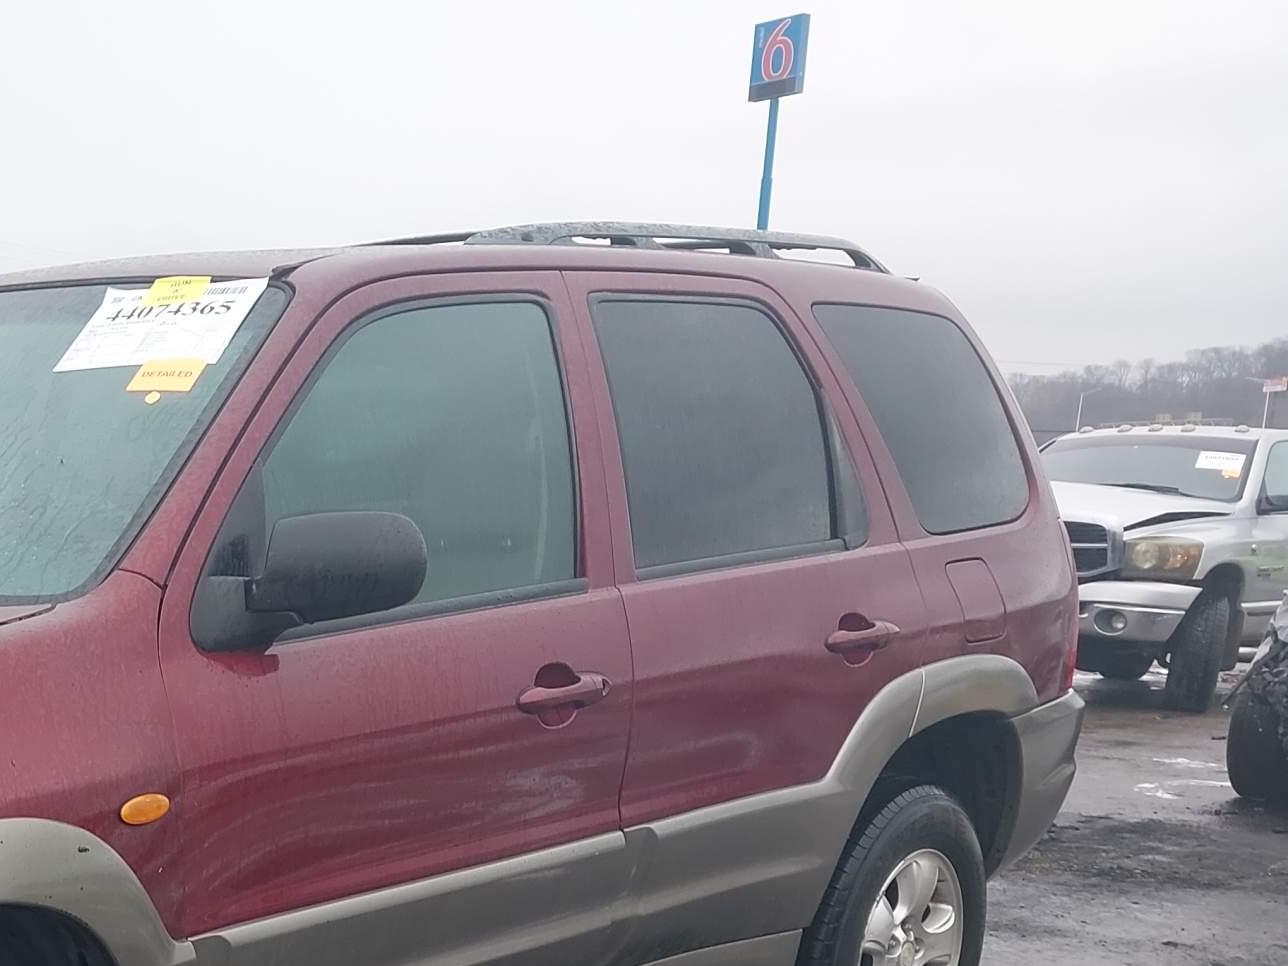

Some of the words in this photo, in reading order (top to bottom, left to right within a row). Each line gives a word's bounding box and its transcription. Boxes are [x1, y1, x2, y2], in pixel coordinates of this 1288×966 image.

[761, 18, 794, 82] 6
[106, 300, 237, 322] 44074365
[141, 369, 193, 378] DETAILED
